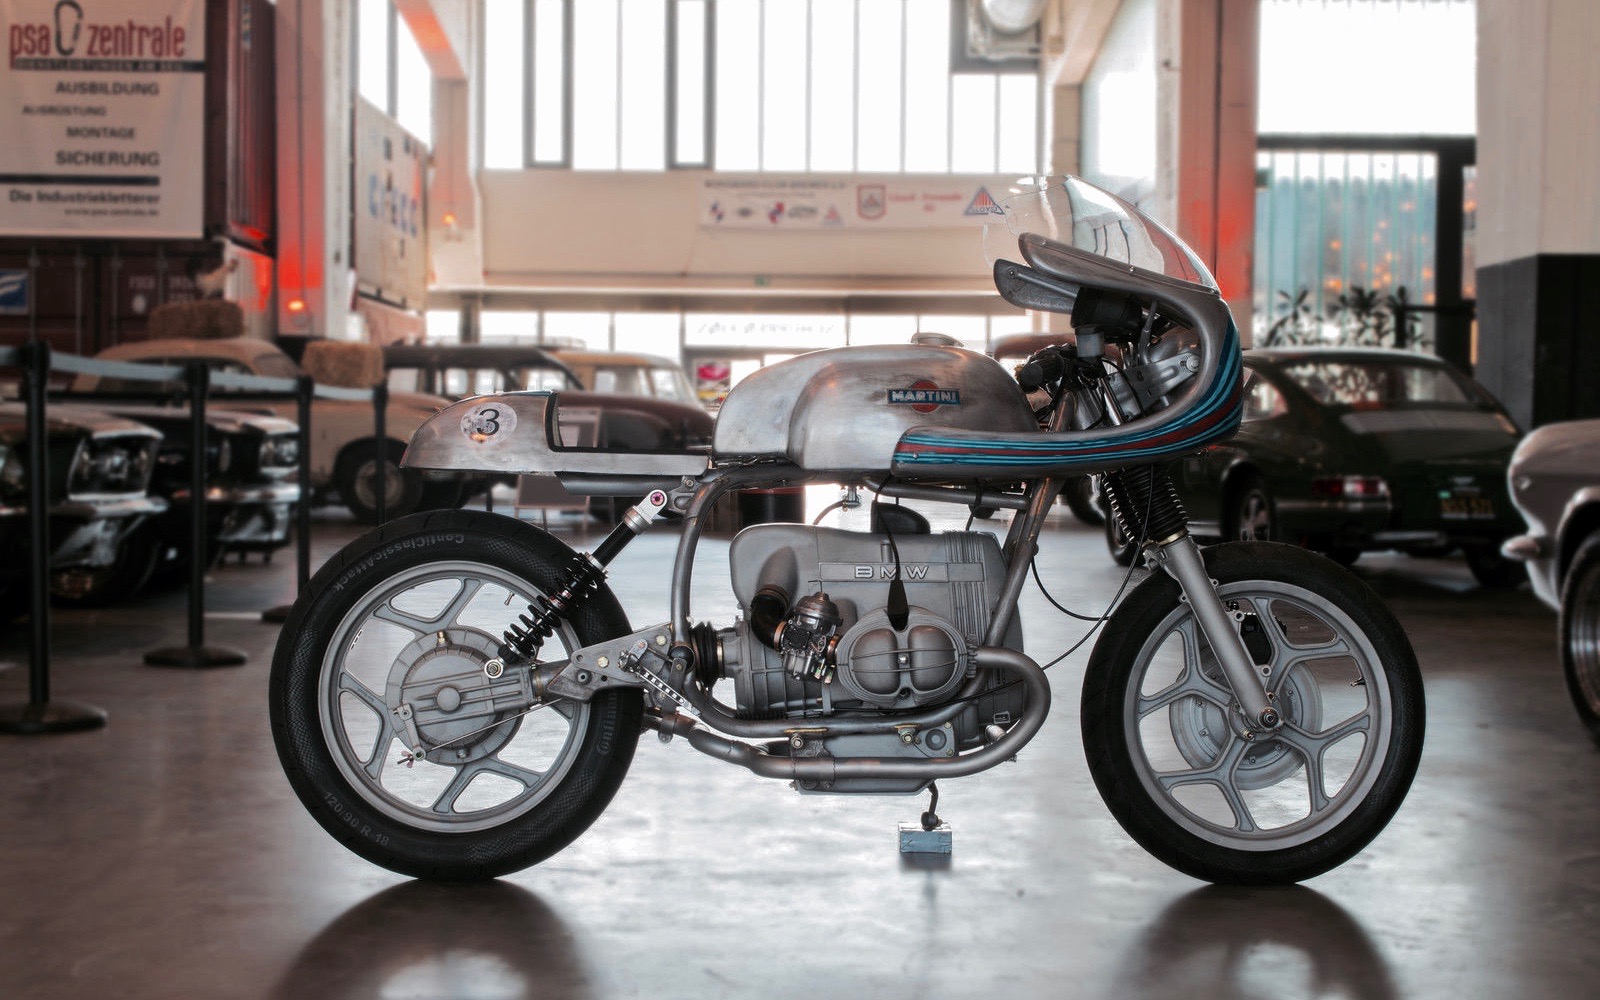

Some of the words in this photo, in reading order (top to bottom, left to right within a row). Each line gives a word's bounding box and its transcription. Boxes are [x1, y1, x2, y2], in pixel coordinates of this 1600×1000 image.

[9, 23, 50, 71] psa
[87, 16, 187, 58] zentrale
[56, 82, 160, 96] AUSBILDUNG
[66, 127, 136, 140] MONTAGE
[56, 151, 161, 167] SICHERUNG
[9, 189, 33, 203] Die
[36, 190, 161, 206] Industriekletterer
[891, 390, 957, 403] MARTINI
[476, 408, 500, 436] 3
